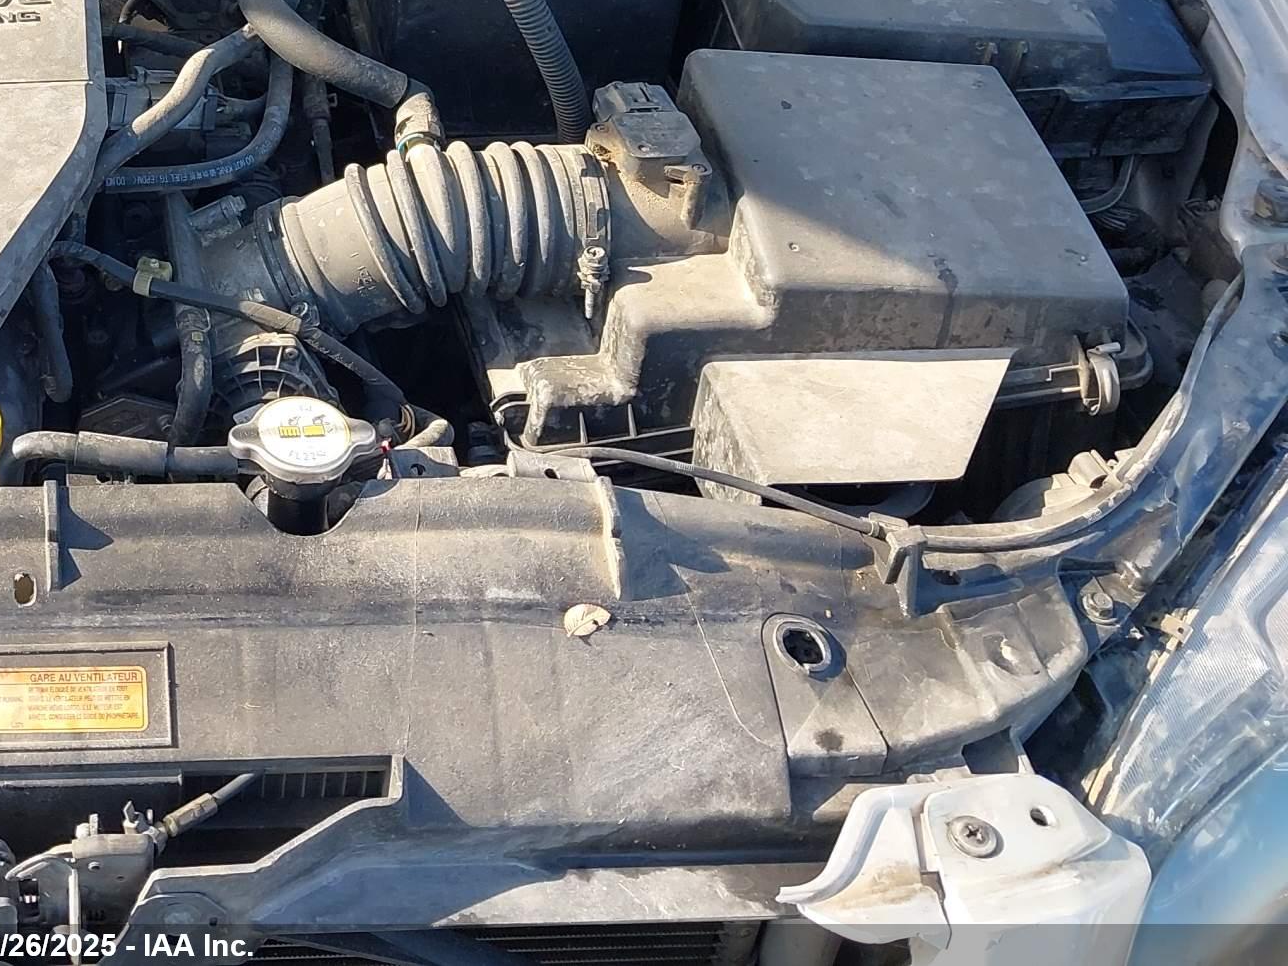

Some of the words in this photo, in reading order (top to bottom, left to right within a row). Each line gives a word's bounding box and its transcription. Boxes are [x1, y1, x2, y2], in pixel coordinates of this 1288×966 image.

[29, 673, 57, 683] GARE
[58, 673, 72, 683] AU
[73, 671, 139, 683] VENTILATEUR
